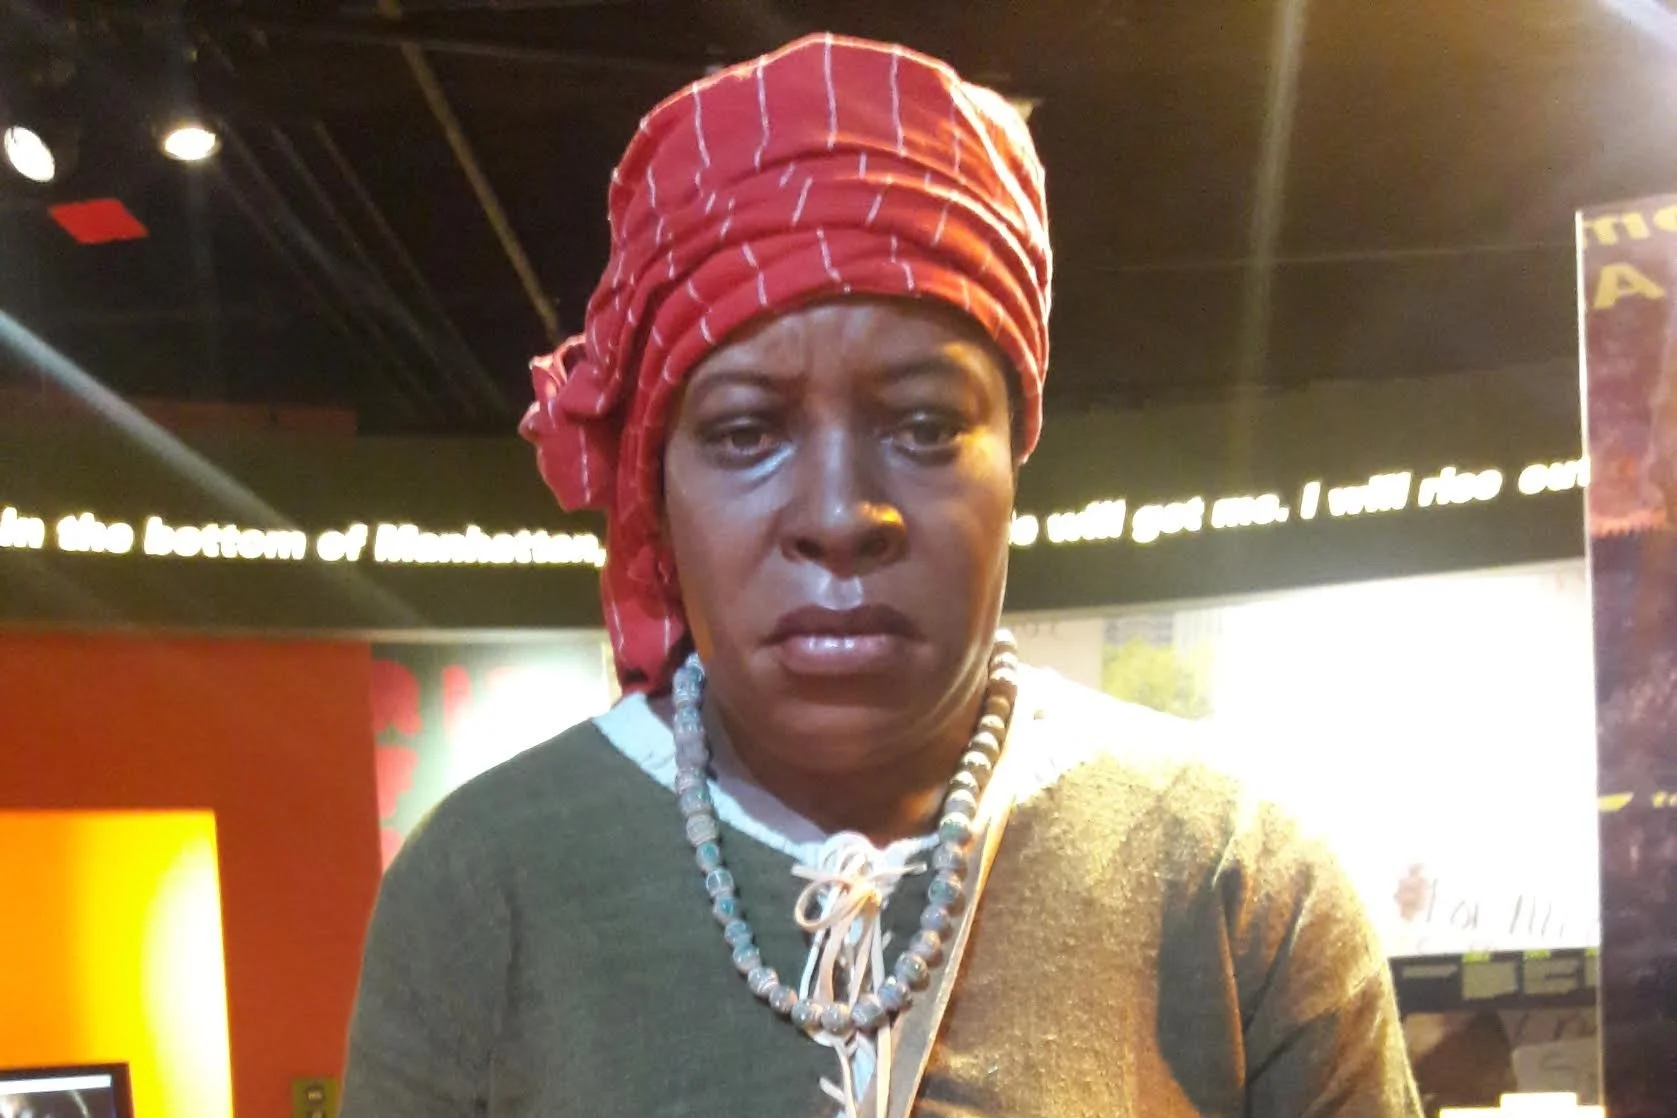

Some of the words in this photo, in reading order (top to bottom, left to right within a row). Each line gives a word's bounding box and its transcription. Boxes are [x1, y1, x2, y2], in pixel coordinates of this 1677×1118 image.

[1299, 480, 1321, 520] I
[1327, 471, 1413, 517] will
[1417, 466, 1504, 507] rise
[56, 511, 135, 554] the
[143, 516, 308, 560] bottom
[316, 522, 369, 562] of
[373, 522, 607, 568] Manhattan,
